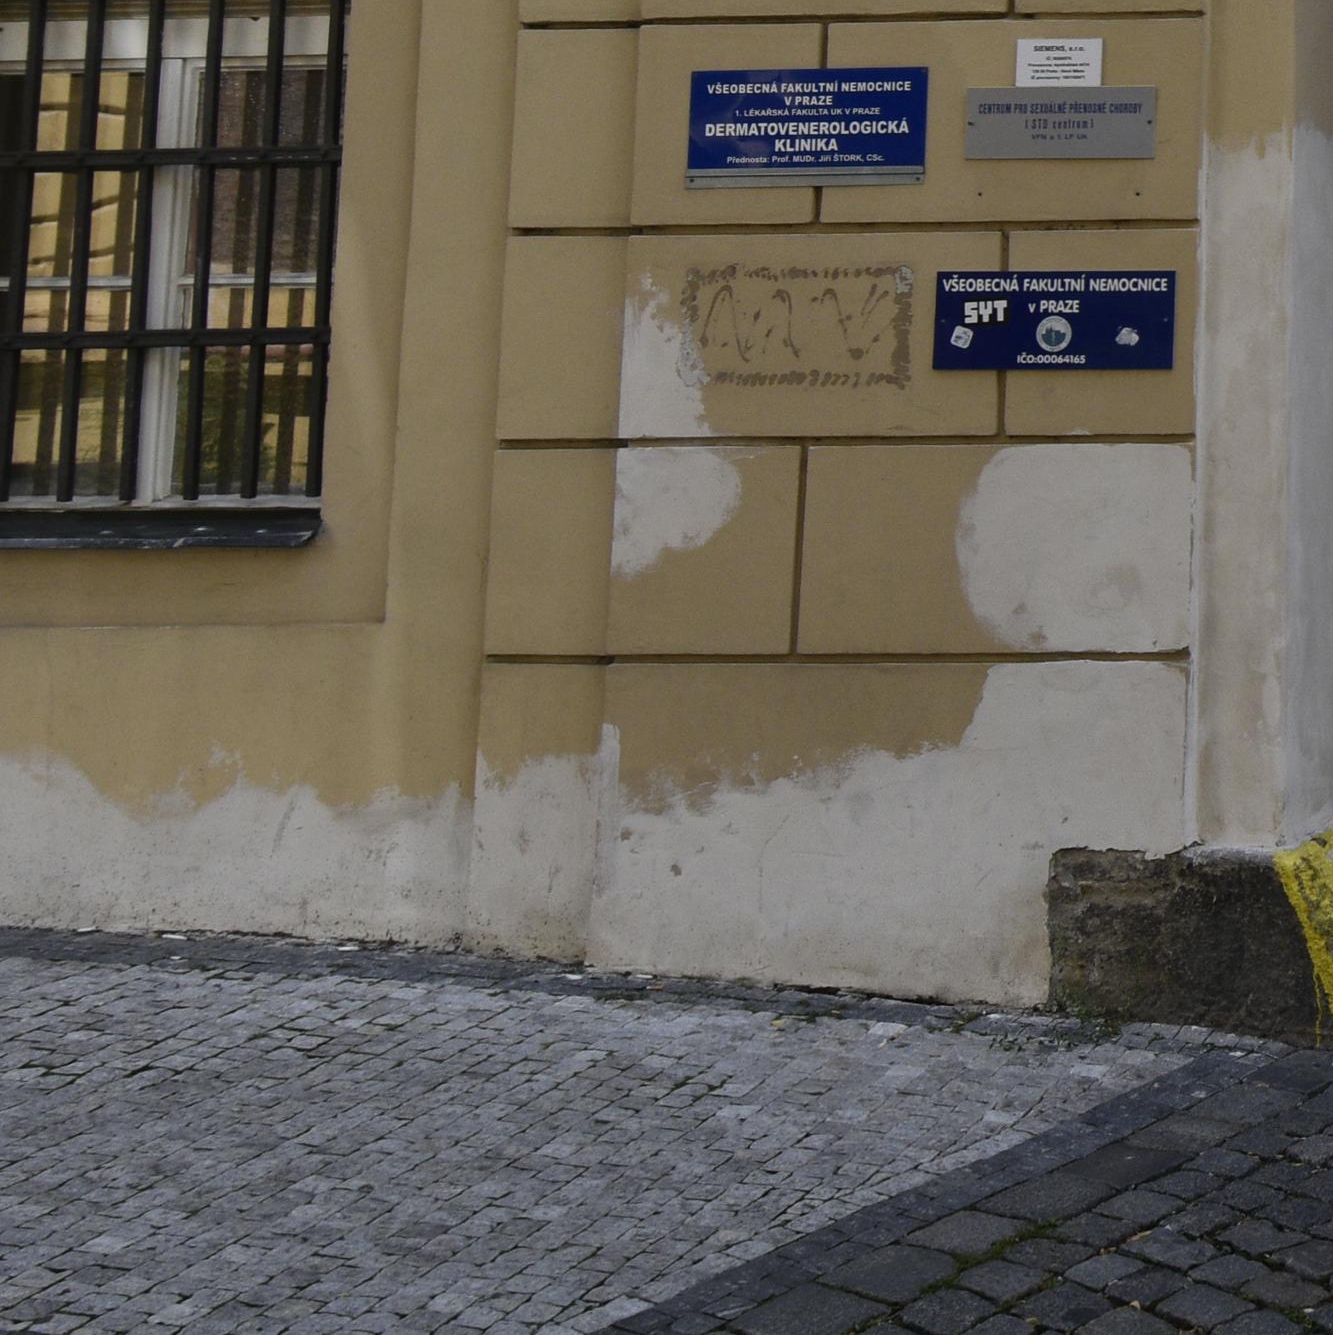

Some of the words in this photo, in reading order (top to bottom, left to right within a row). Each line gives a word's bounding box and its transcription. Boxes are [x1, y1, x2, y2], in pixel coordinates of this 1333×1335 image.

[707, 81, 778, 94] VŠEOBECNÁ
[781, 81, 838, 93] FAKULTNÍ
[841, 81, 912, 92] NEMOCNICE
[784, 96, 793, 106] V
[795, 95, 833, 105] PRAZE
[736, 109, 742, 117] 1.
[744, 108, 790, 117] LÉKAŘSKÁ
[831, 108, 844, 116] UK
[852, 107, 881, 115] PRAZE
[978, 103, 1012, 115] CENTRUM
[1013, 103, 1027, 114] PRO
[1109, 103, 1143, 114] CHOROBY
[705, 117, 909, 137] DERMATOVENEROLOGICKÁ
[775, 138, 838, 152] KLINIKA
[727, 155, 770, 164] Přednosta:
[793, 155, 816, 163] MUDr.
[818, 154, 832, 162] Jiří
[833, 153, 864, 163] ŠTORK,
[943, 274, 1019, 292] VŠEOBECNÁ
[1023, 274, 1086, 292] FAKULTNÍ
[1090, 278, 1168, 292] NEMOCNICE
[1028, 303, 1036, 313] v
[1039, 300, 1080, 313] PRAZE
